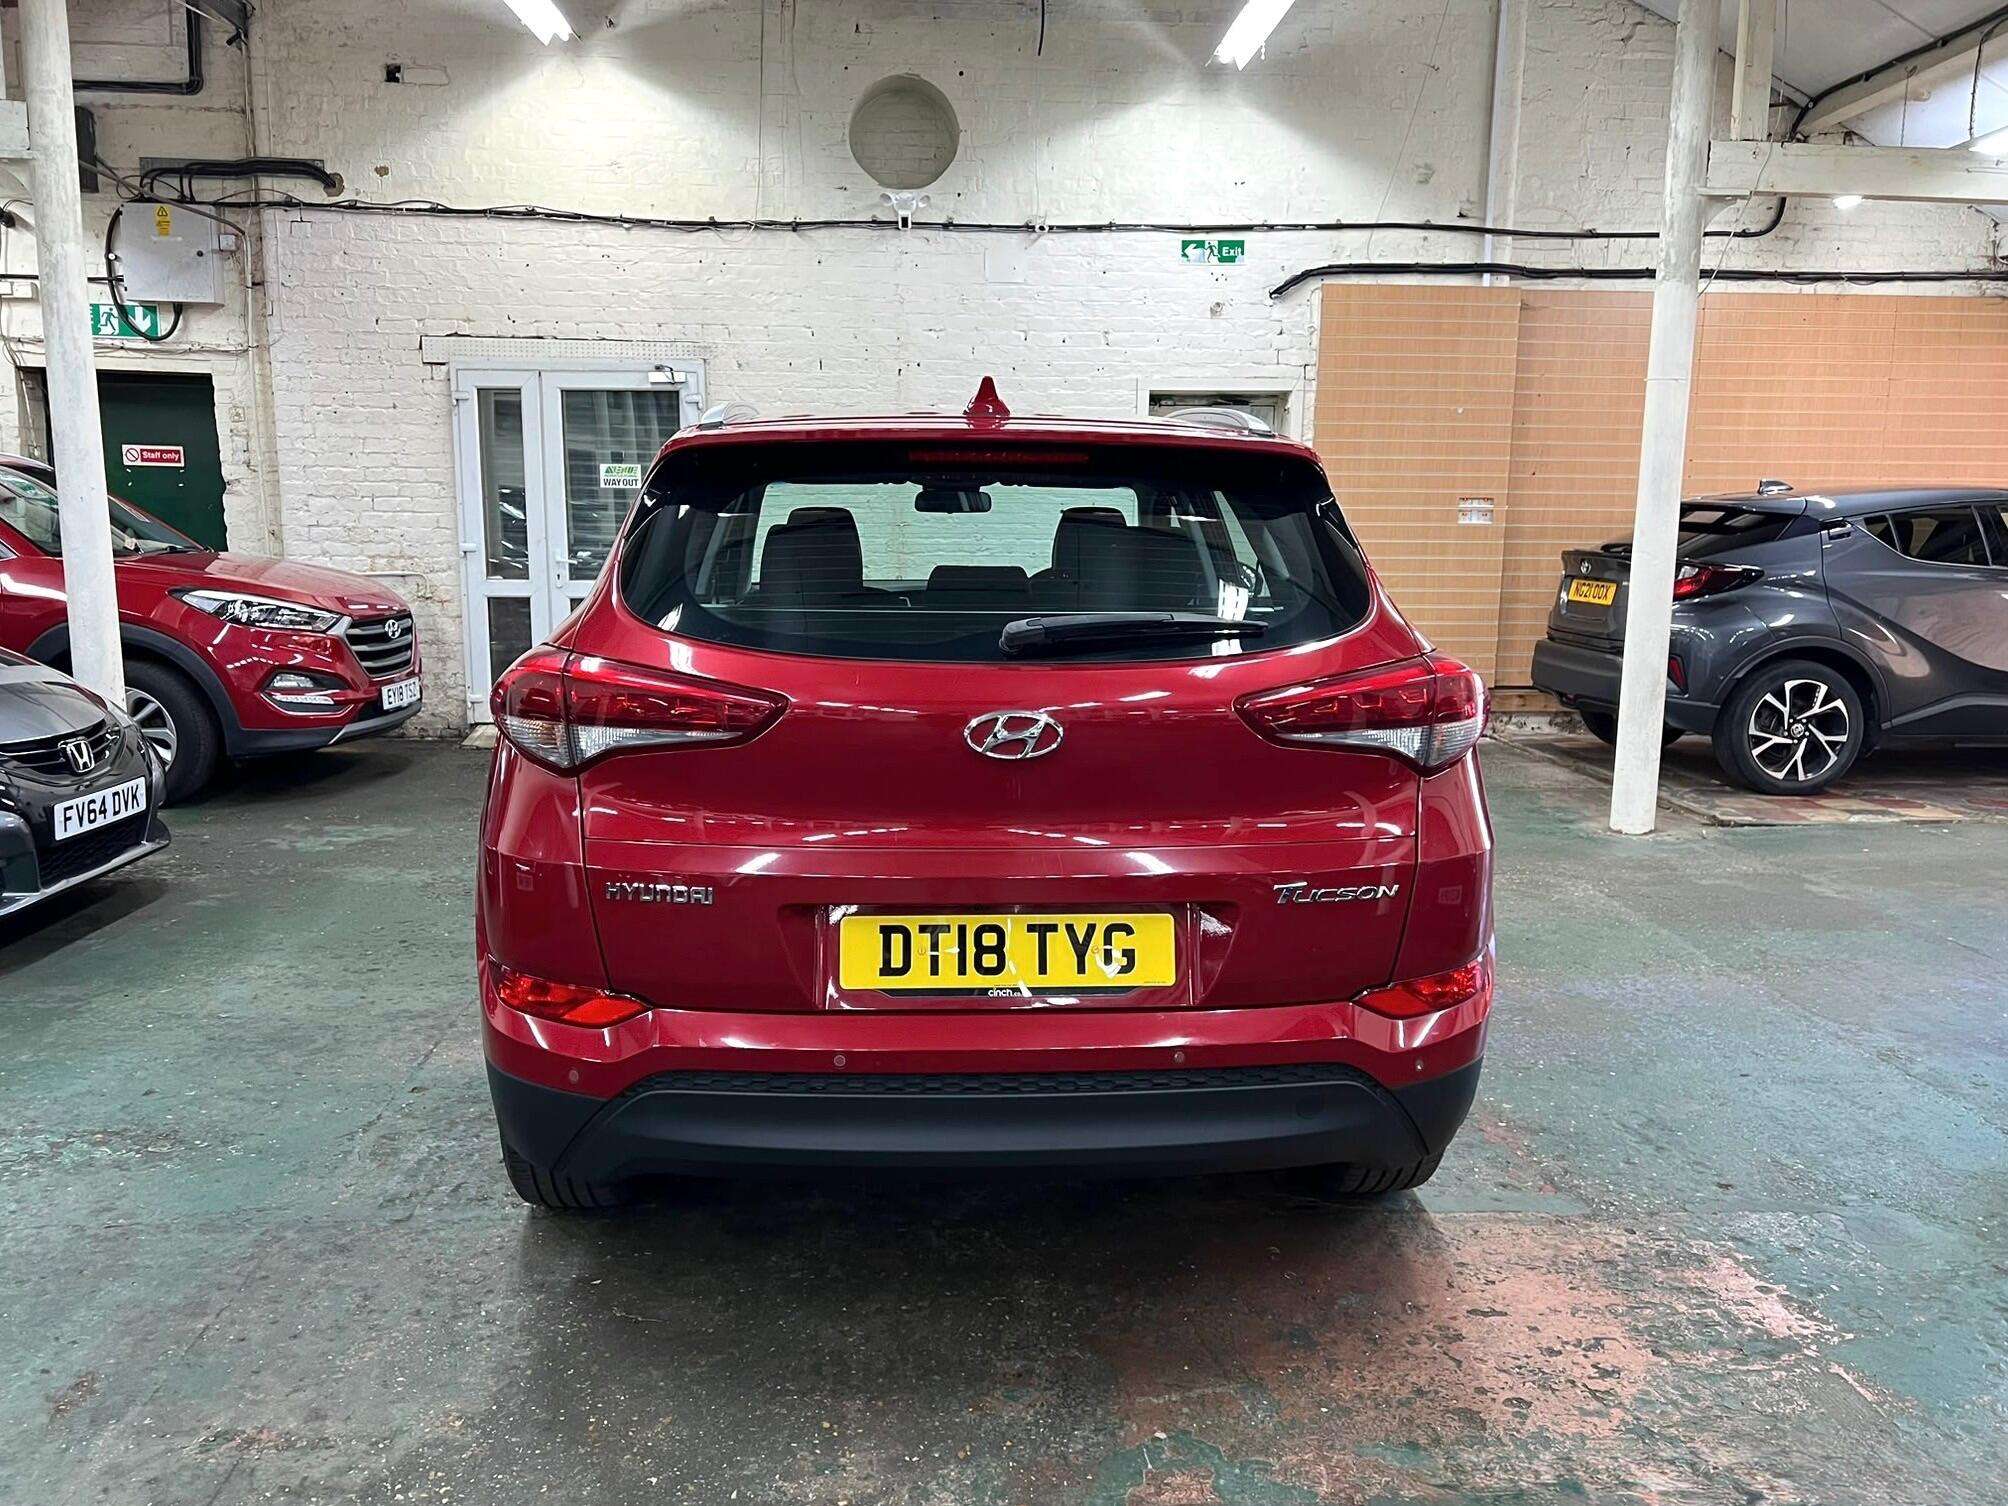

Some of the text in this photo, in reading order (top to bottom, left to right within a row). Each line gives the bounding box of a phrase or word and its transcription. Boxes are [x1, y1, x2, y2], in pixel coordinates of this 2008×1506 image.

[1222, 247, 1241, 256] Exit
[142, 451, 179, 461] Staff only
[603, 478, 639, 486] WAY OUT
[63, 784, 140, 833] FV64 DVK
[605, 882, 713, 905] HYUNDAI
[878, 923, 1136, 977] DT18 TYG
